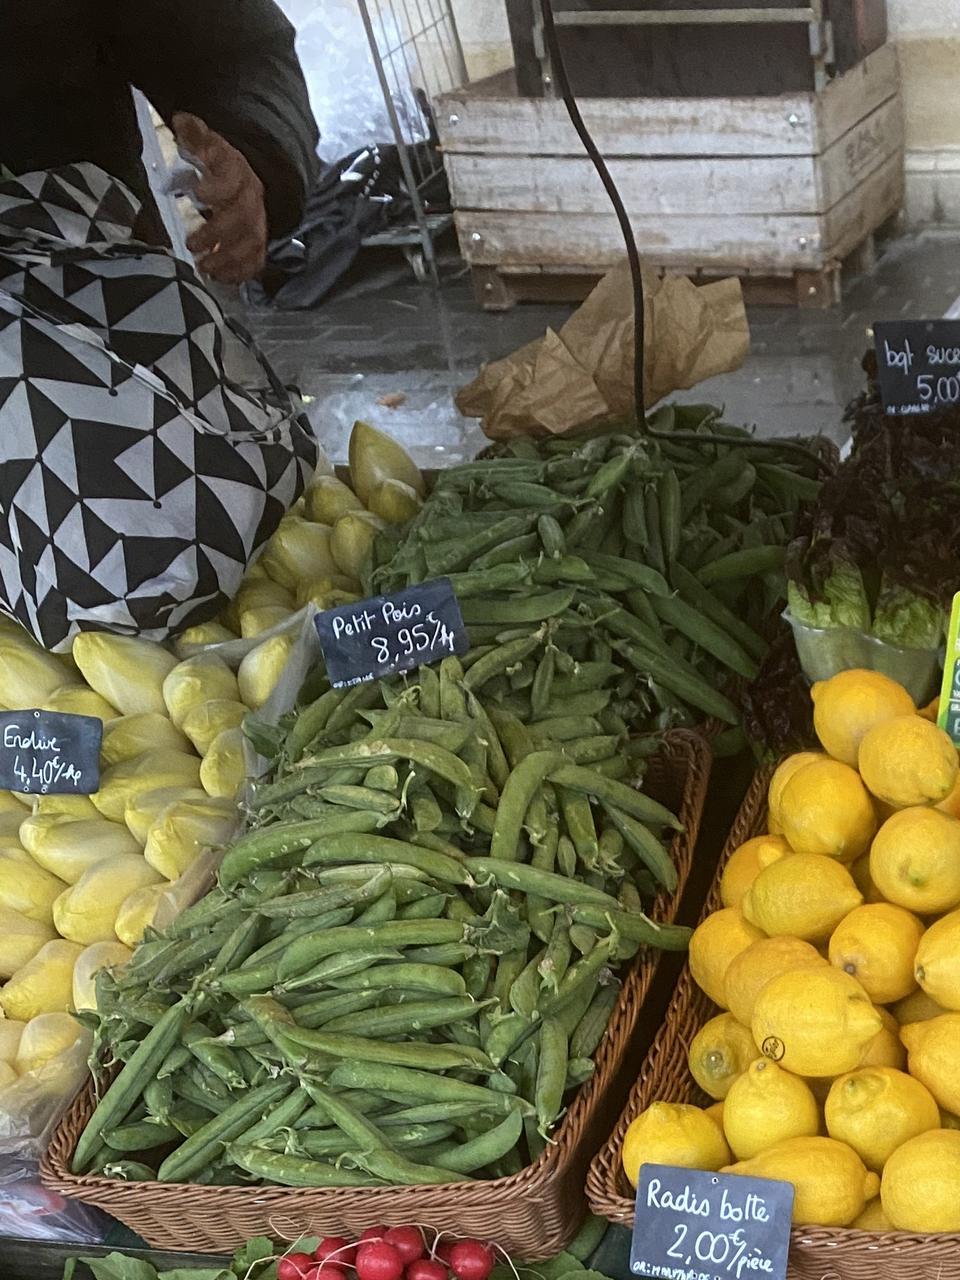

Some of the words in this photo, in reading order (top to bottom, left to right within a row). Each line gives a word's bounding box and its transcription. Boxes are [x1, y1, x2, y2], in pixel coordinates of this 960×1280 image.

[332, 610, 376, 640] Petit
[381, 602, 421, 625] Pois
[3, 724, 61, 752] Endive
[647, 1178, 710, 1217] Radis
